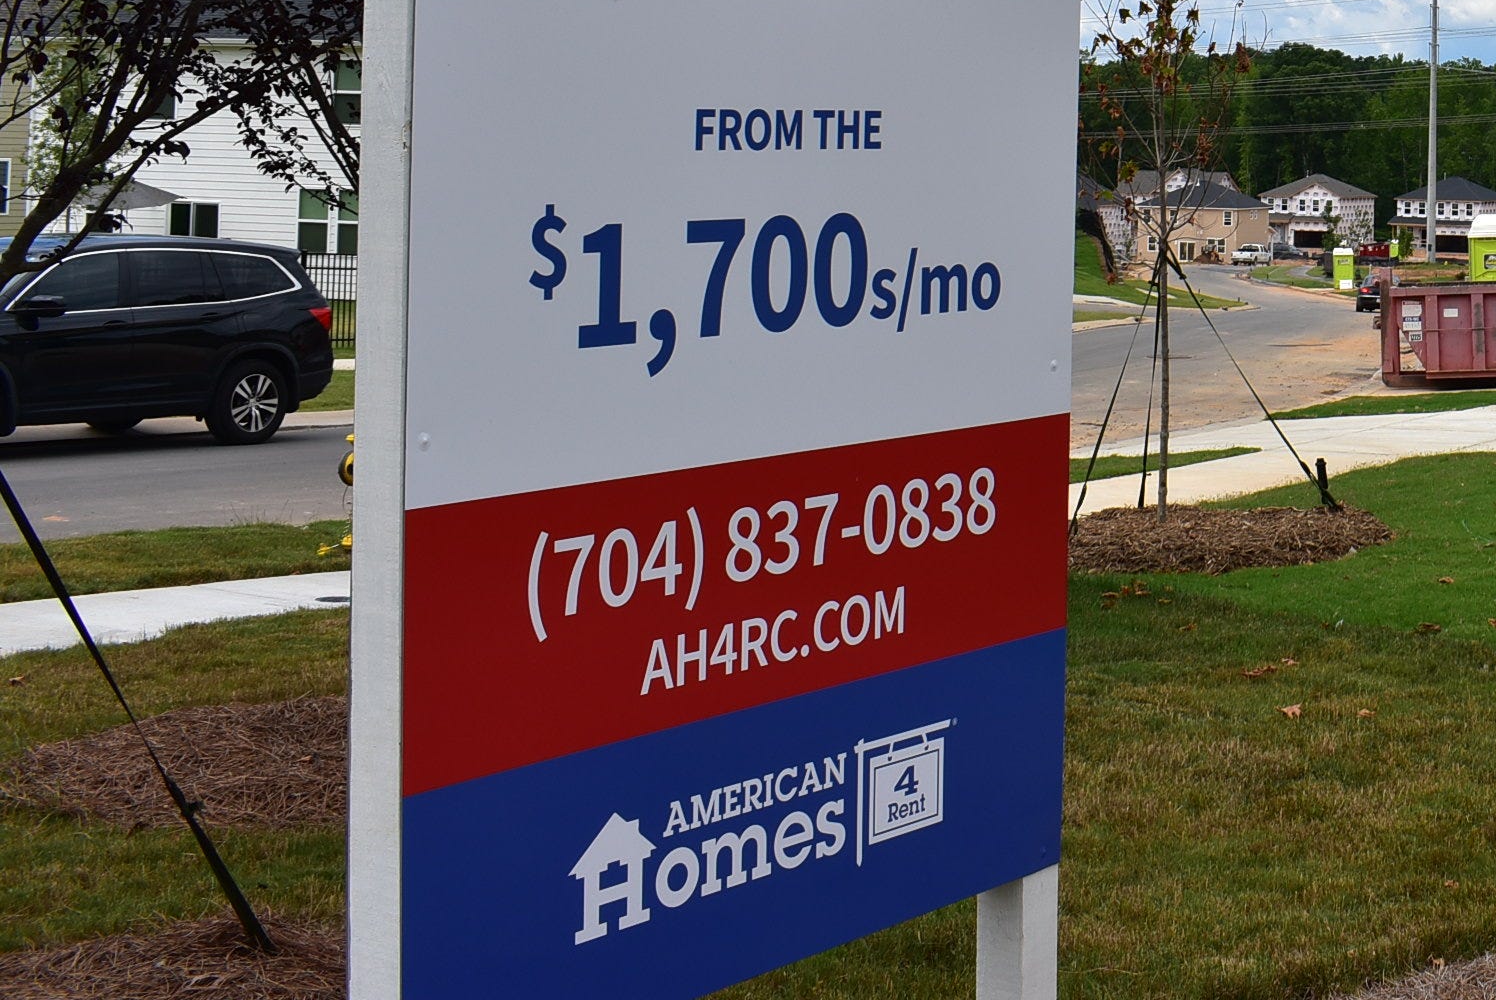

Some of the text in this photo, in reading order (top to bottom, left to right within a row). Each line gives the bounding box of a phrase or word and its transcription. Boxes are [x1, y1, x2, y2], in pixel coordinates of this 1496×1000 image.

[694, 108, 883, 152] FROM THE
[528, 203, 1002, 378] $1,700s/mo
[527, 467, 997, 642] (704) 837-0838
[639, 585, 906, 696] AH4RC.COM
[661, 752, 847, 838] AMERICAN
[887, 793, 926, 823] Rent
[894, 764, 919, 796] 4
[568, 796, 847, 945] Homes
